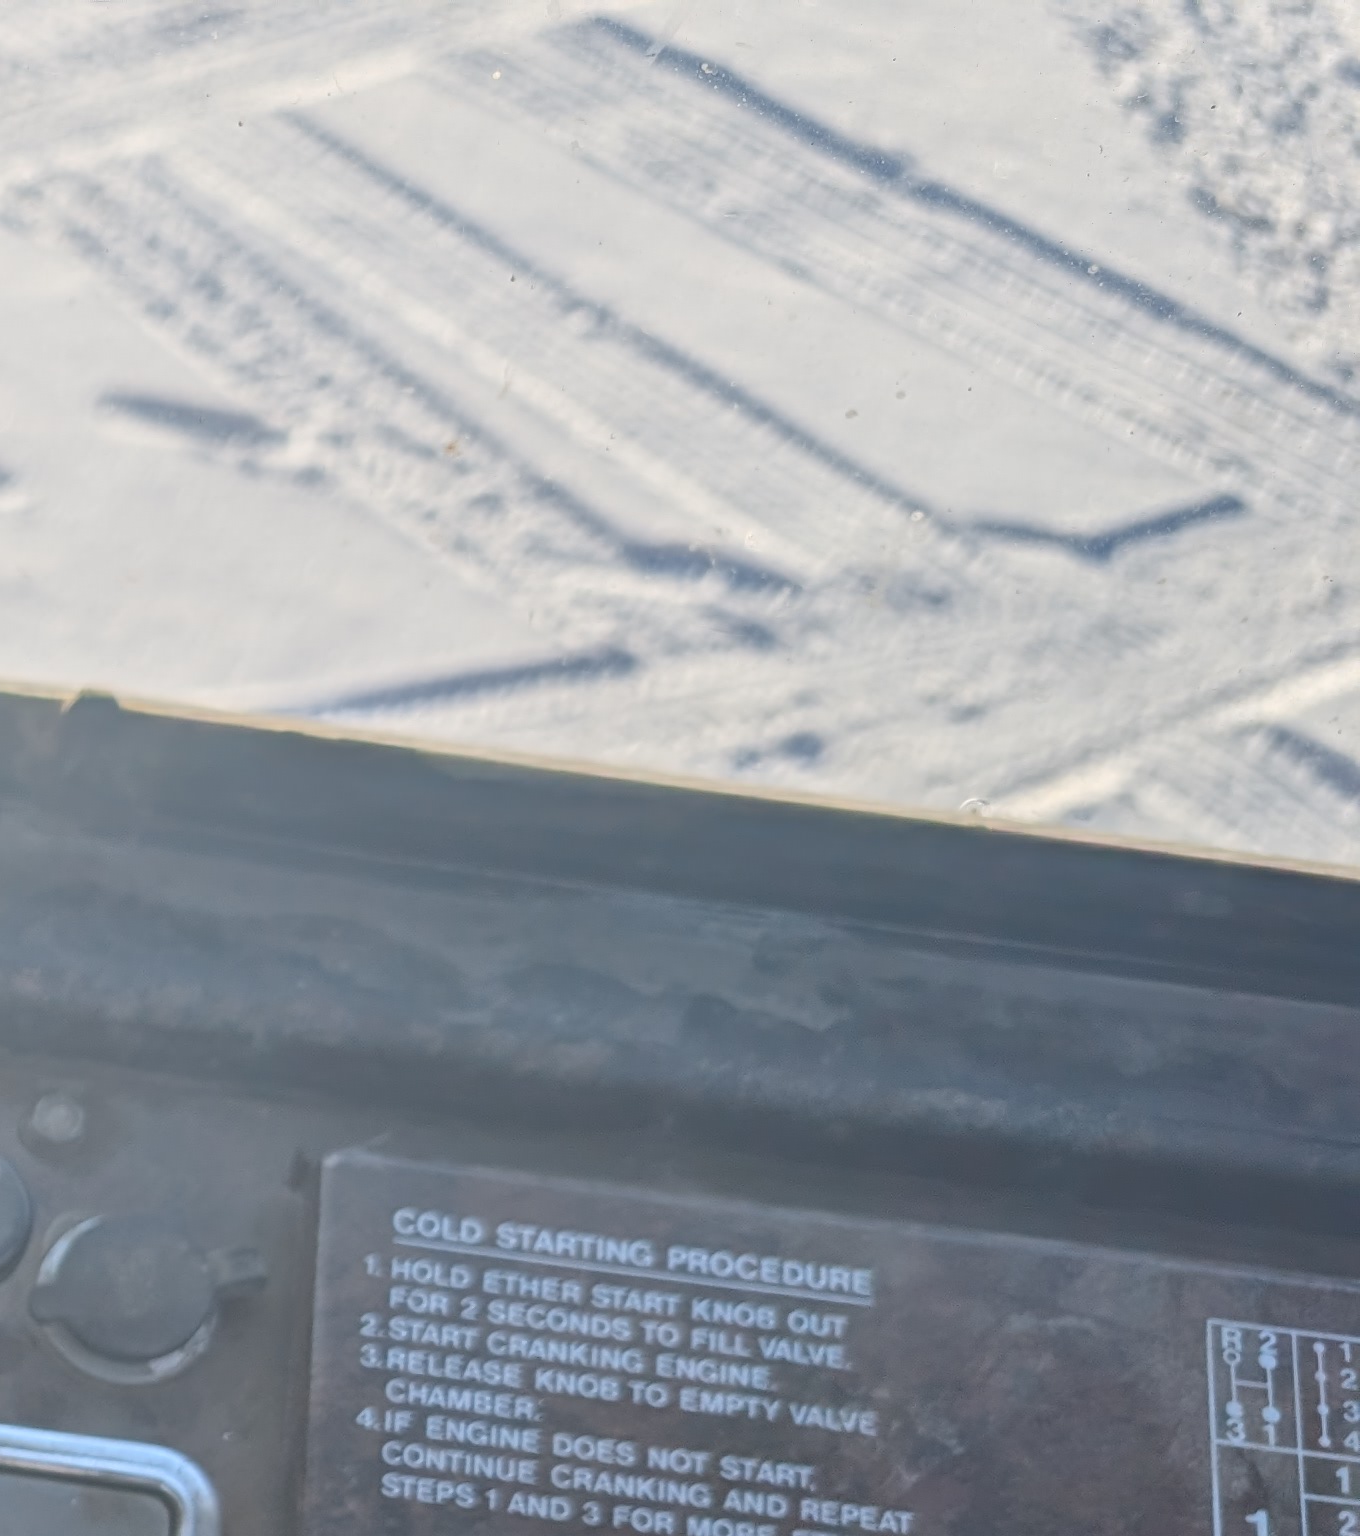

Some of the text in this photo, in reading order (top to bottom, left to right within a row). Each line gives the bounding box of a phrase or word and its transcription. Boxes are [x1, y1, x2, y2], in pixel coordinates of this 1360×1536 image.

[393, 1208, 873, 1296] COLD STARTING PROCEDURE
[392, 1258, 471, 1288] HOLD
[484, 1271, 581, 1302] ETHER
[592, 1285, 679, 1315] START
[692, 1300, 776, 1329] KNOB
[788, 1311, 847, 1338] OUT
[390, 1287, 448, 1314] FOR
[461, 1297, 477, 1319] 2
[488, 1301, 631, 1340] SECONDS
[644, 1322, 680, 1346] TO
[692, 1329, 748, 1356] FILL
[1222, 1327, 1242, 1352] R
[1259, 1330, 1277, 1355] 2
[389, 1317, 478, 1349] START
[487, 1332, 644, 1373] CRANKING
[1340, 1342, 1351, 1362] 1
[387, 1349, 520, 1387] RELEASE
[536, 1370, 619, 1400] KNOB
[629, 1382, 668, 1407] TO
[680, 1389, 780, 1421] EMPTY
[790, 1404, 878, 1436] VALVE
[1340, 1367, 1358, 1390] 2
[1226, 1418, 1246, 1443] 3
[1343, 1401, 1360, 1422] 3
[385, 1411, 411, 1432] IF
[427, 1416, 540, 1453] ENGINE
[553, 1433, 635, 1465] DOES
[648, 1447, 710, 1473] NOT
[1263, 1423, 1276, 1446] 1
[382, 1441, 915, 1534] CONTINUE CRANKING AND REPEAT
[1335, 1466, 1350, 1494] 1
[382, 1473, 476, 1508] STEPS
[486, 1489, 498, 1510] 1
[507, 1493, 572, 1521] AND
[582, 1502, 600, 1525] 3
[613, 1506, 674, 1534] FOR
